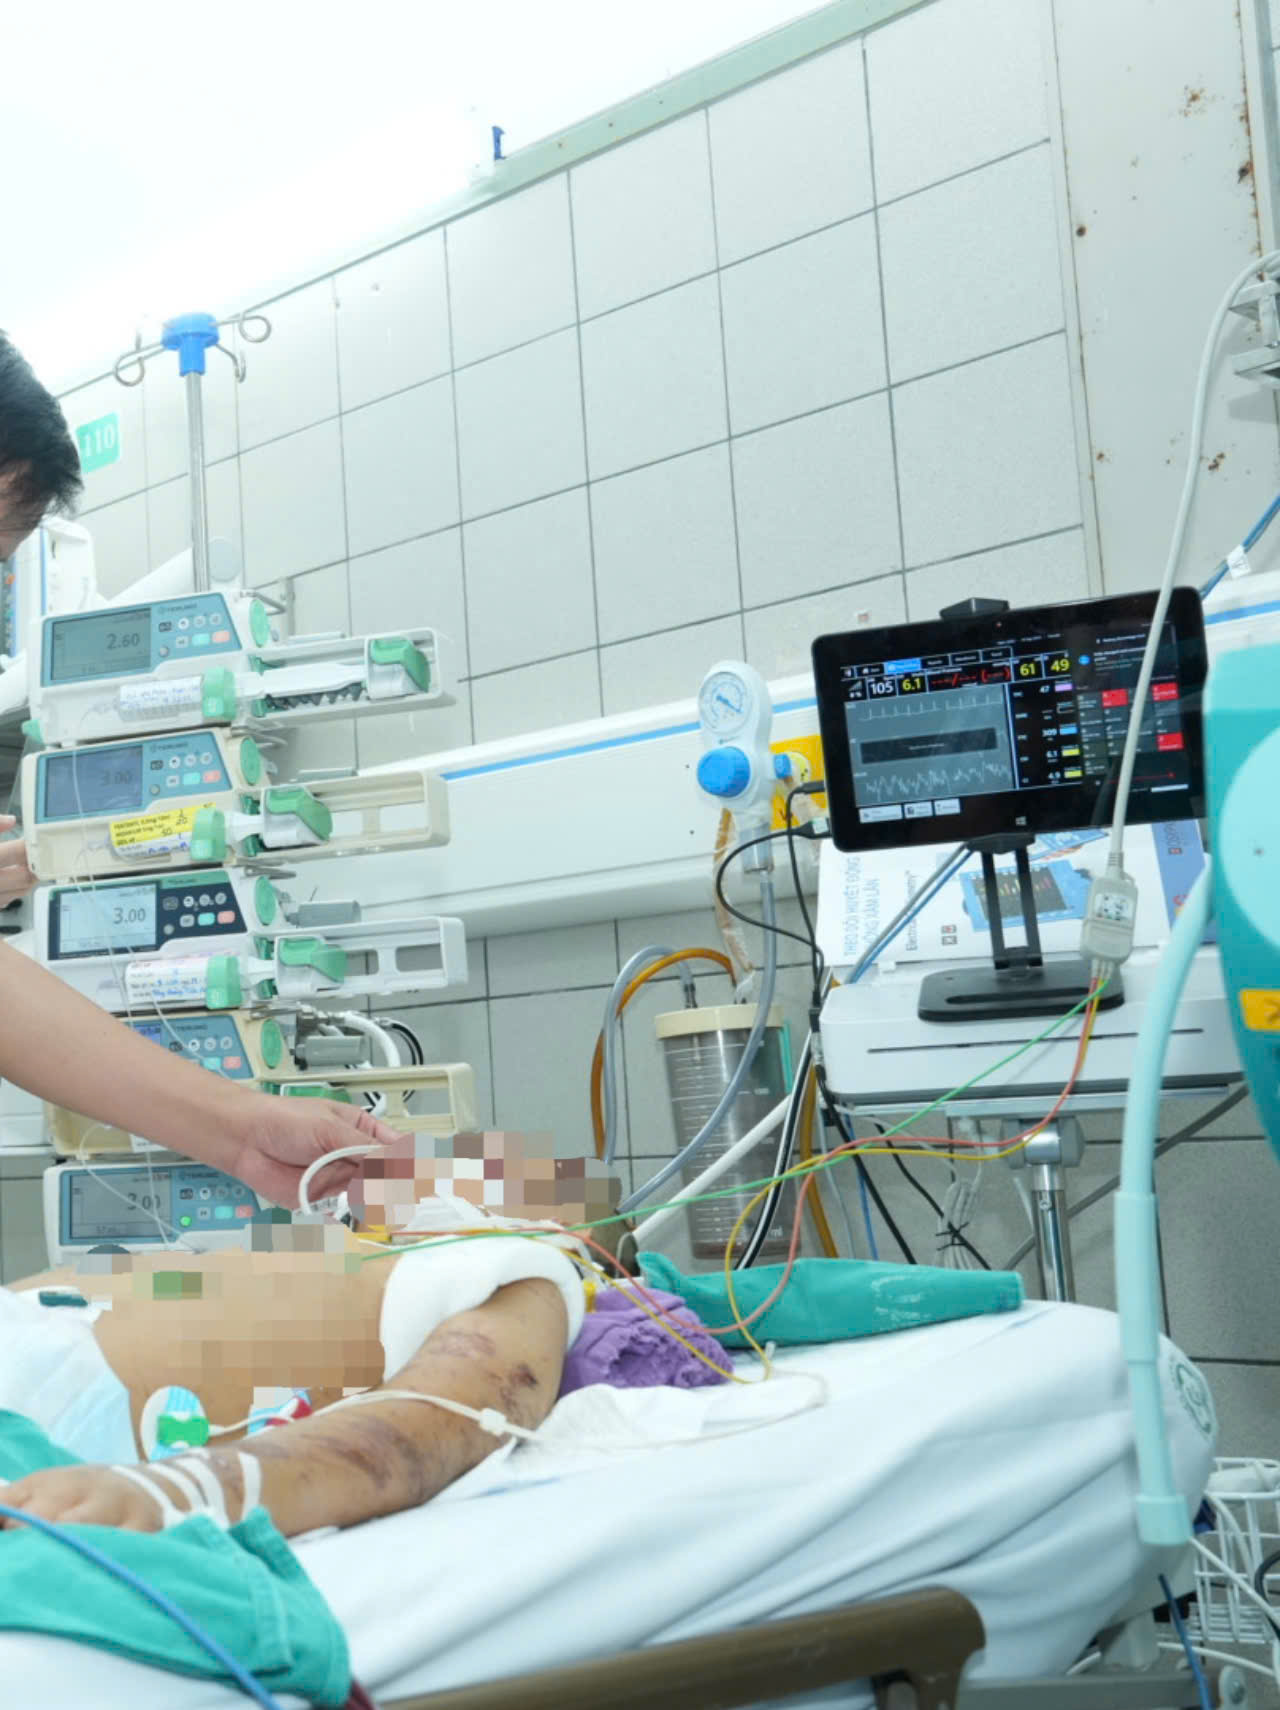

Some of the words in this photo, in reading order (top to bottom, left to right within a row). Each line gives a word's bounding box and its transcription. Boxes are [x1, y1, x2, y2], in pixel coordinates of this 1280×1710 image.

[106, 632, 140, 650] 2.60
[1019, 663, 1036, 677] 61
[1051, 659, 1070, 672] 49
[870, 681, 894, 696] 105
[902, 678, 922, 691] 6.1
[113, 907, 146, 925] 3.00
